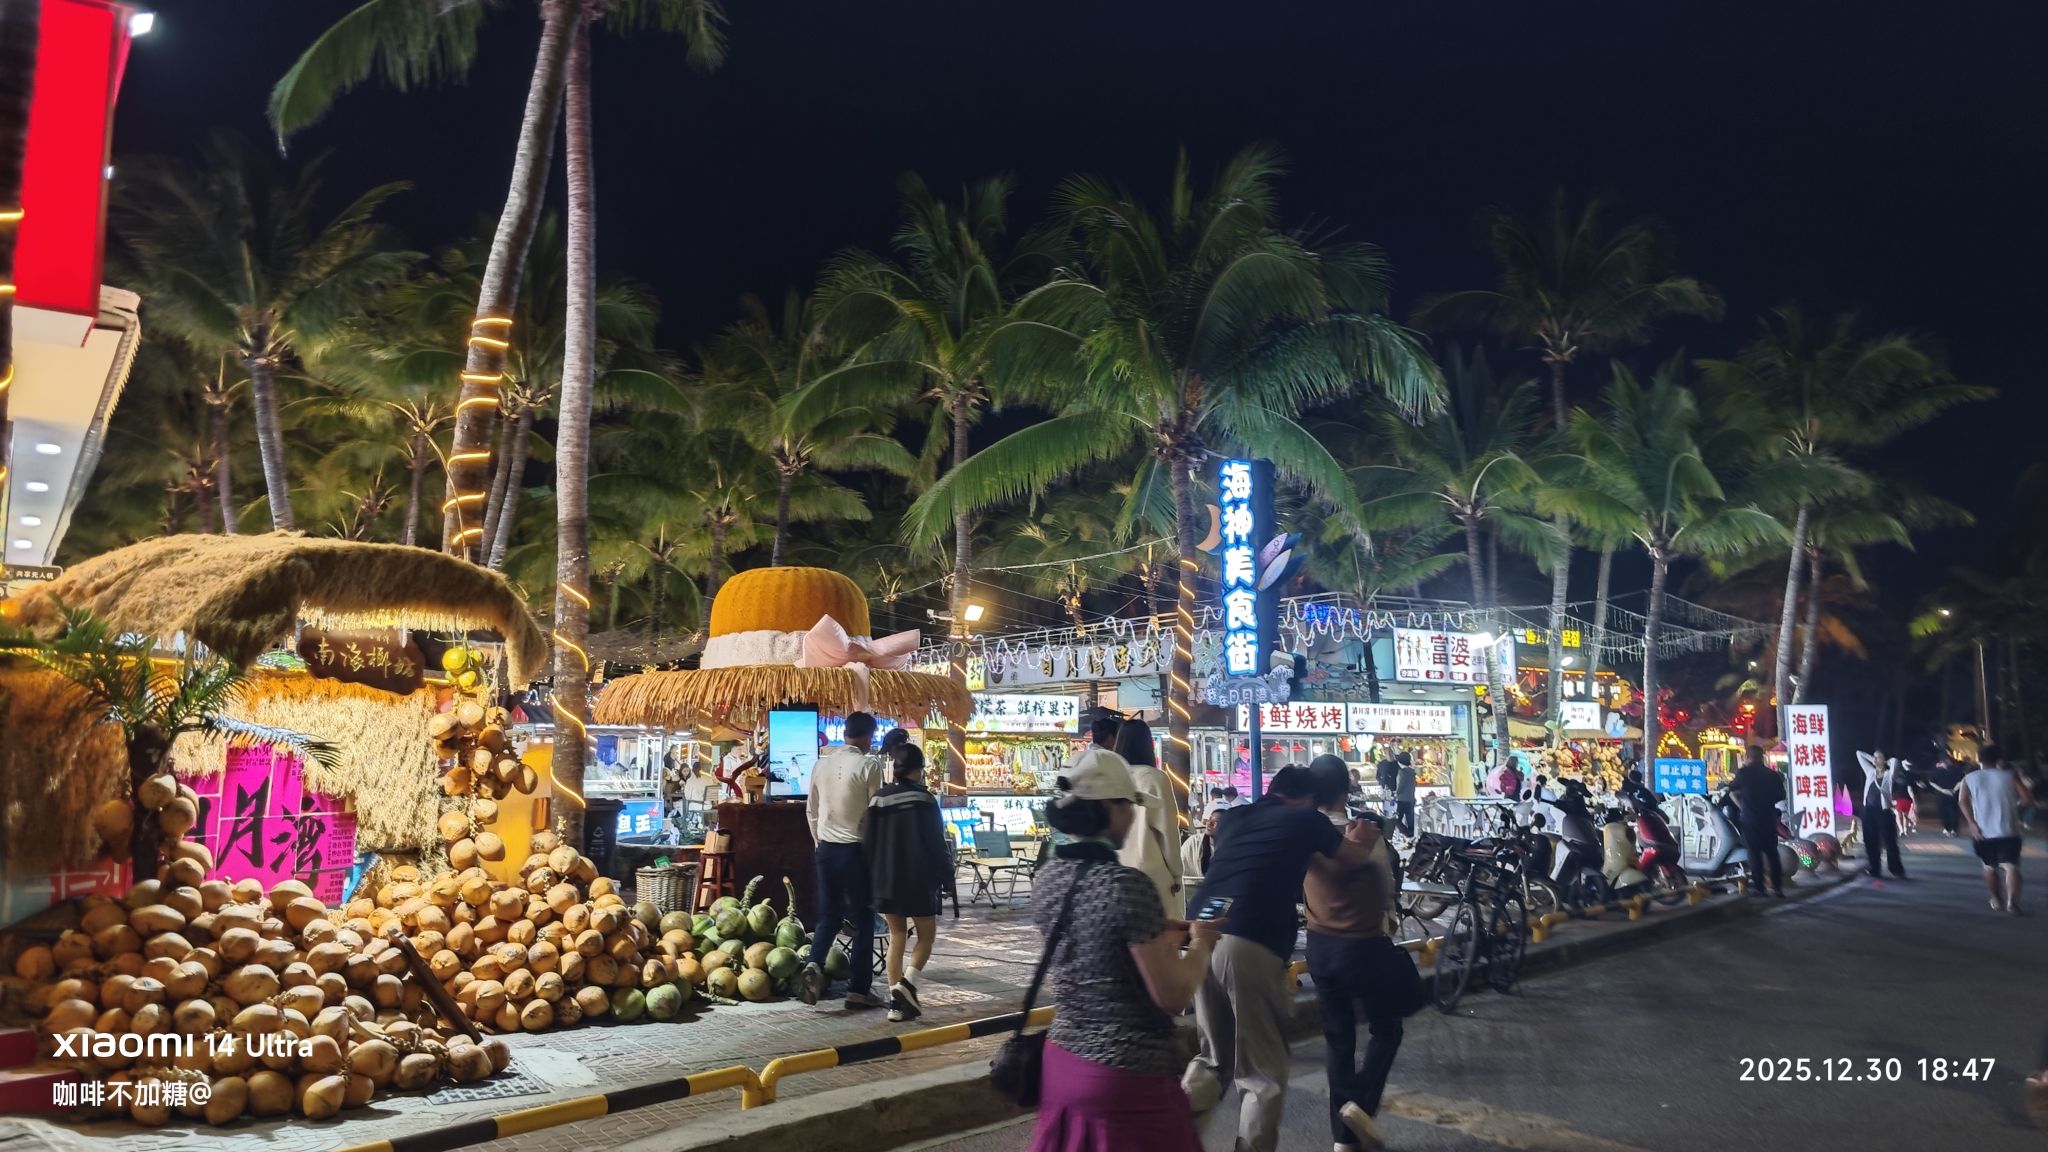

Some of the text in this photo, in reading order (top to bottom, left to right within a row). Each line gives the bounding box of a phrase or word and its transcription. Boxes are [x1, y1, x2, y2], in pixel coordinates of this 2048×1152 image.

[1220, 461, 1257, 675] 海神美食街
[1018, 700, 1074, 716] 鲜榨果汁
[1242, 704, 1342, 729] 海鲜烧烤
[1793, 713, 1825, 736] 海鲜
[1794, 743, 1826, 767] 烧烤
[1796, 775, 1828, 798] 啤酒
[1802, 806, 1831, 829] 小炒
